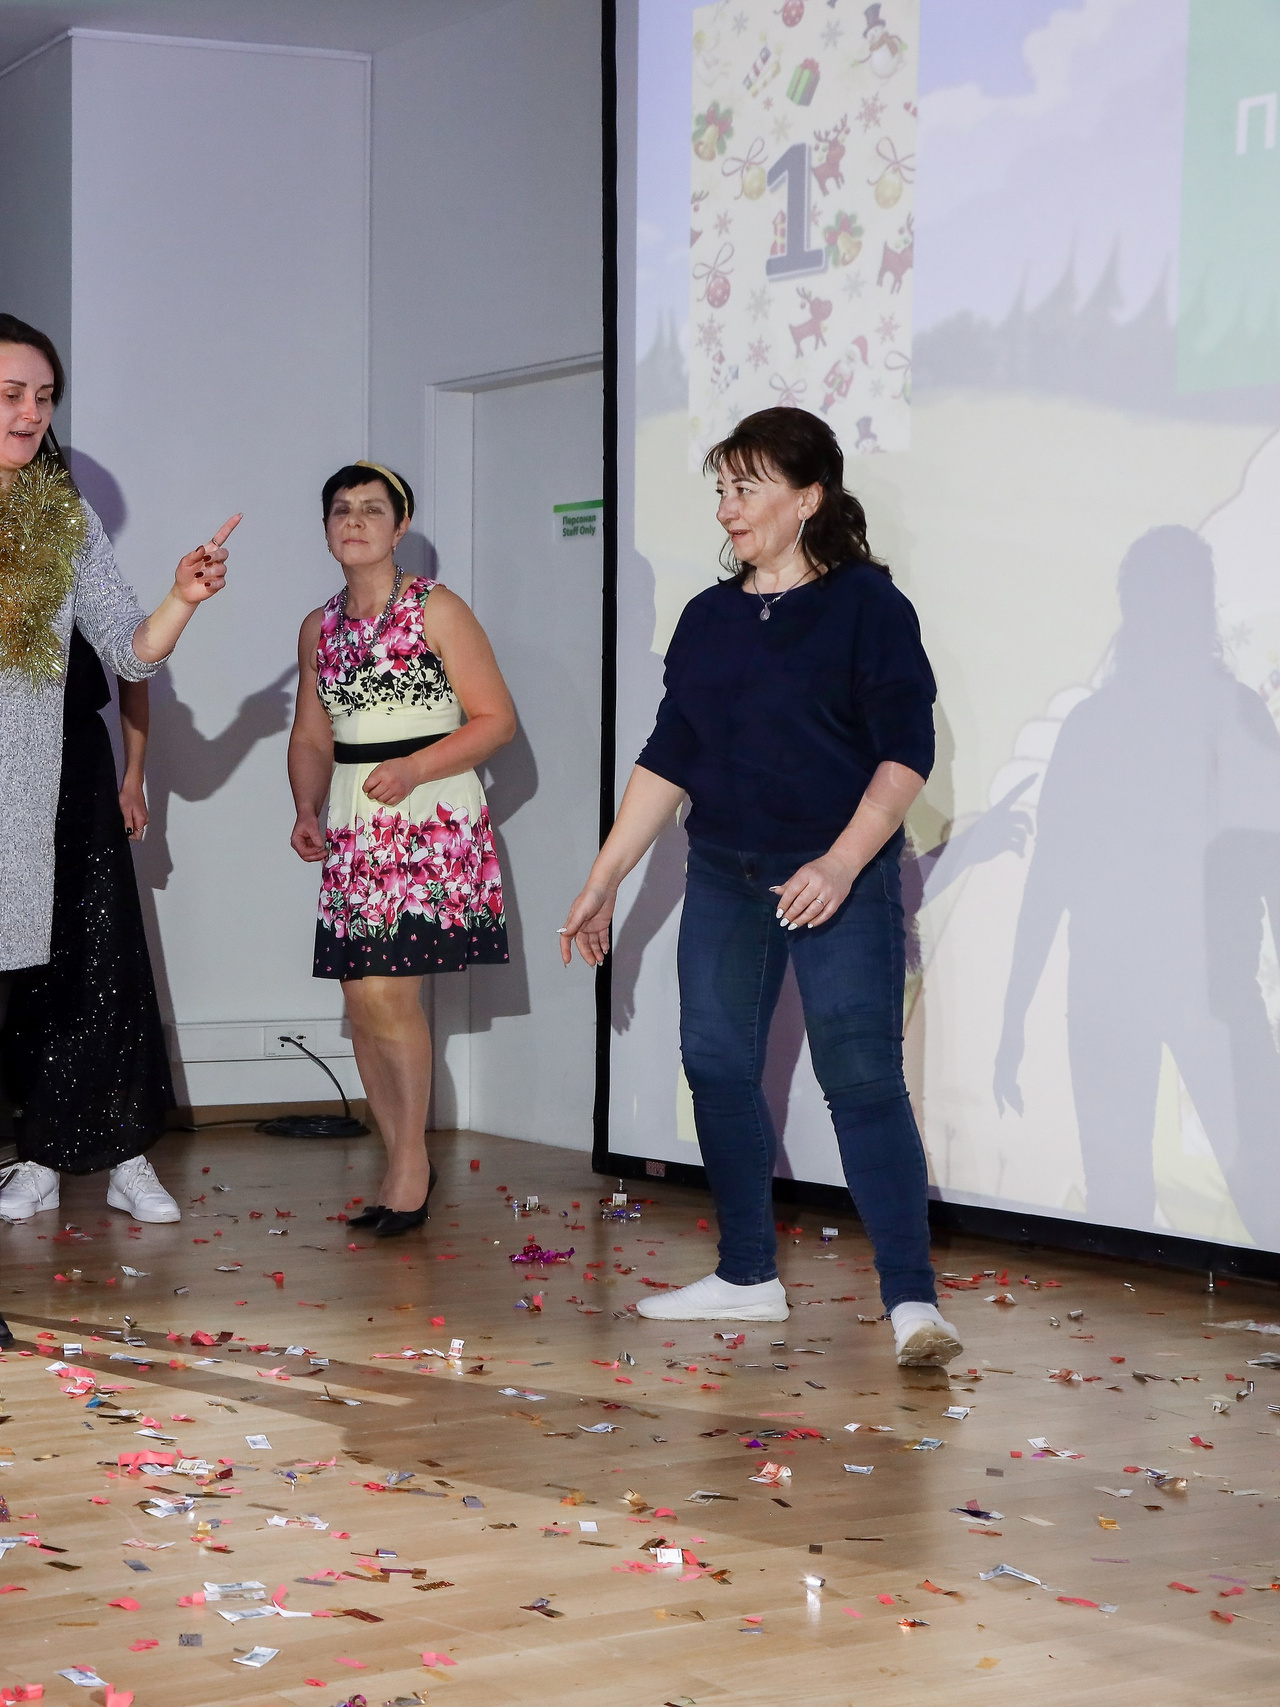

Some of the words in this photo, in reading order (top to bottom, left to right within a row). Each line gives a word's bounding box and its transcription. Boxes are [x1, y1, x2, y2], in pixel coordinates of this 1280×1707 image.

[766, 143, 827, 280] 1
[562, 515, 596, 525] Персонал
[563, 526, 578, 536] Staff
[580, 525, 595, 535] Only
